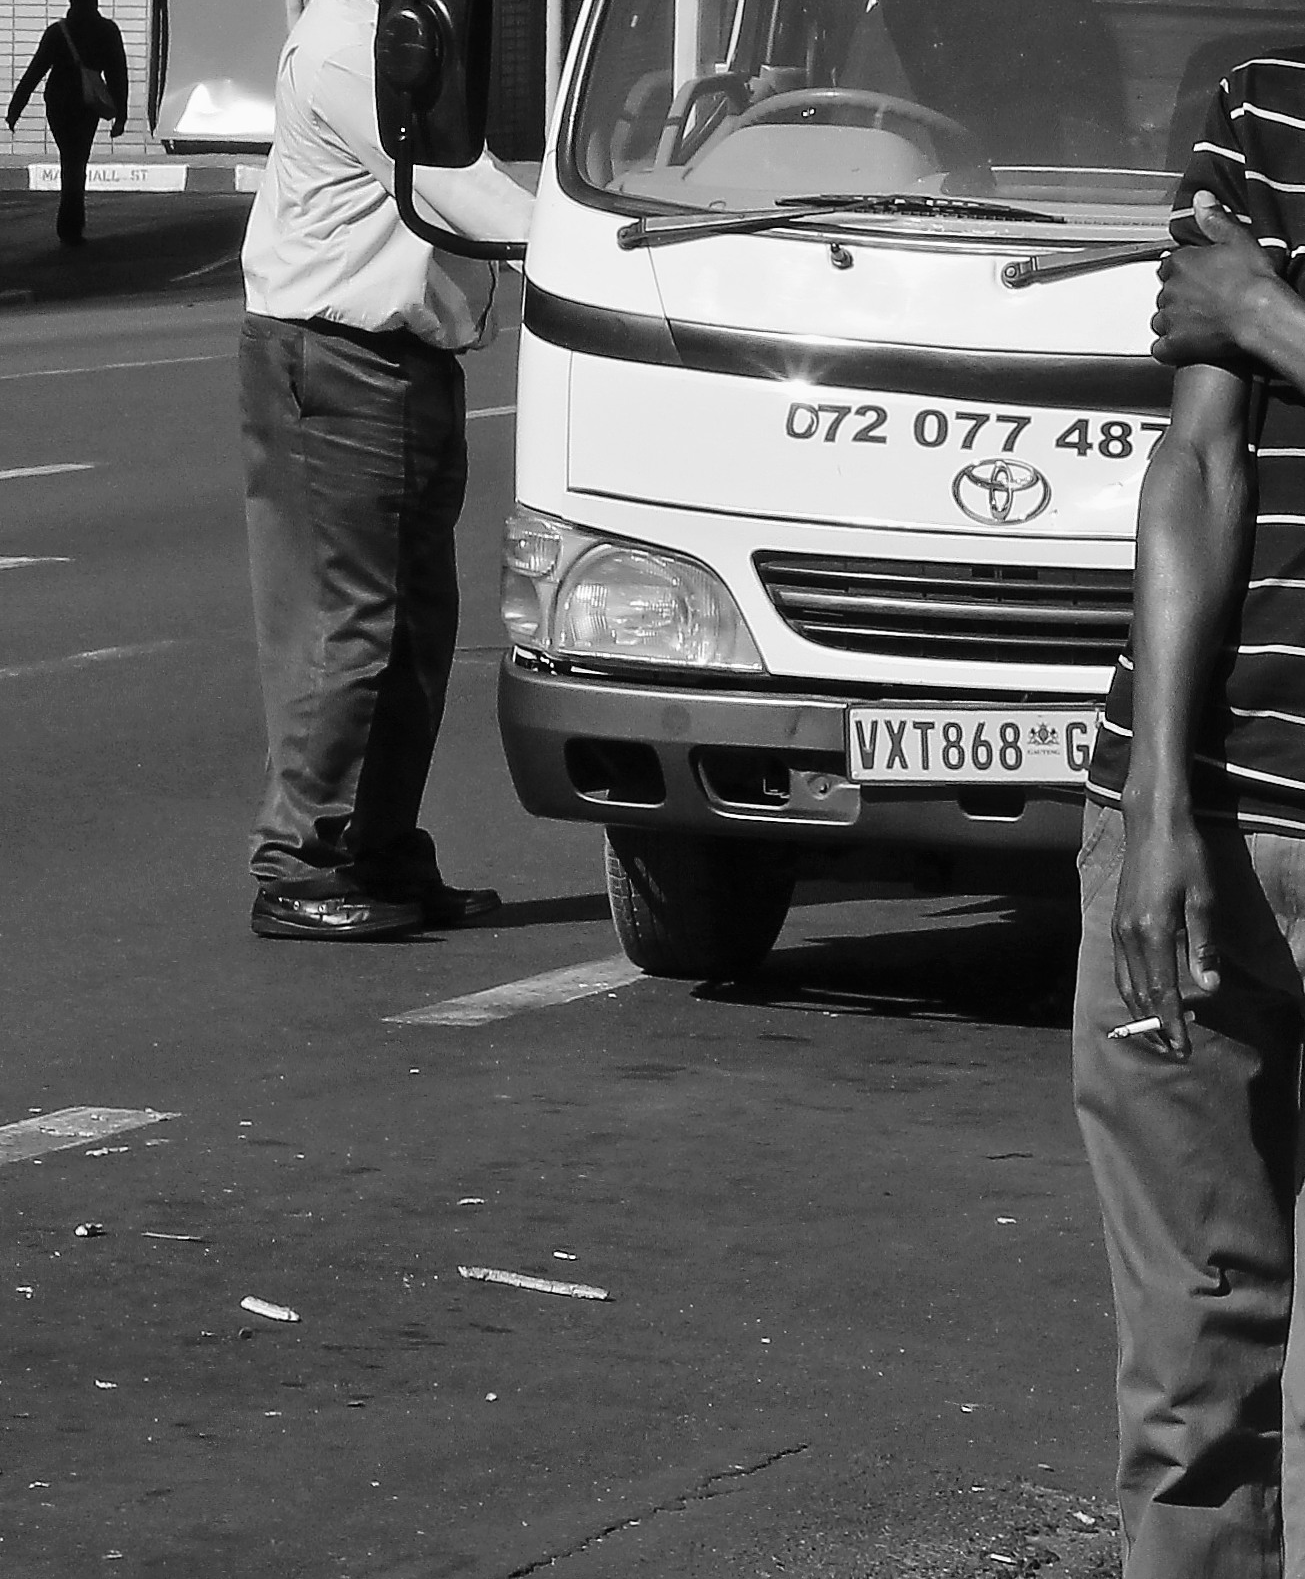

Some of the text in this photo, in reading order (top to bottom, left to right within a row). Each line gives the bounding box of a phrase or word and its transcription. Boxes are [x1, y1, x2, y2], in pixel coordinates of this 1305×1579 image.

[42, 169, 120, 184] MAALL
[786, 402, 889, 444] 072
[913, 409, 1032, 453] 077
[855, 720, 1024, 772] VXT868
